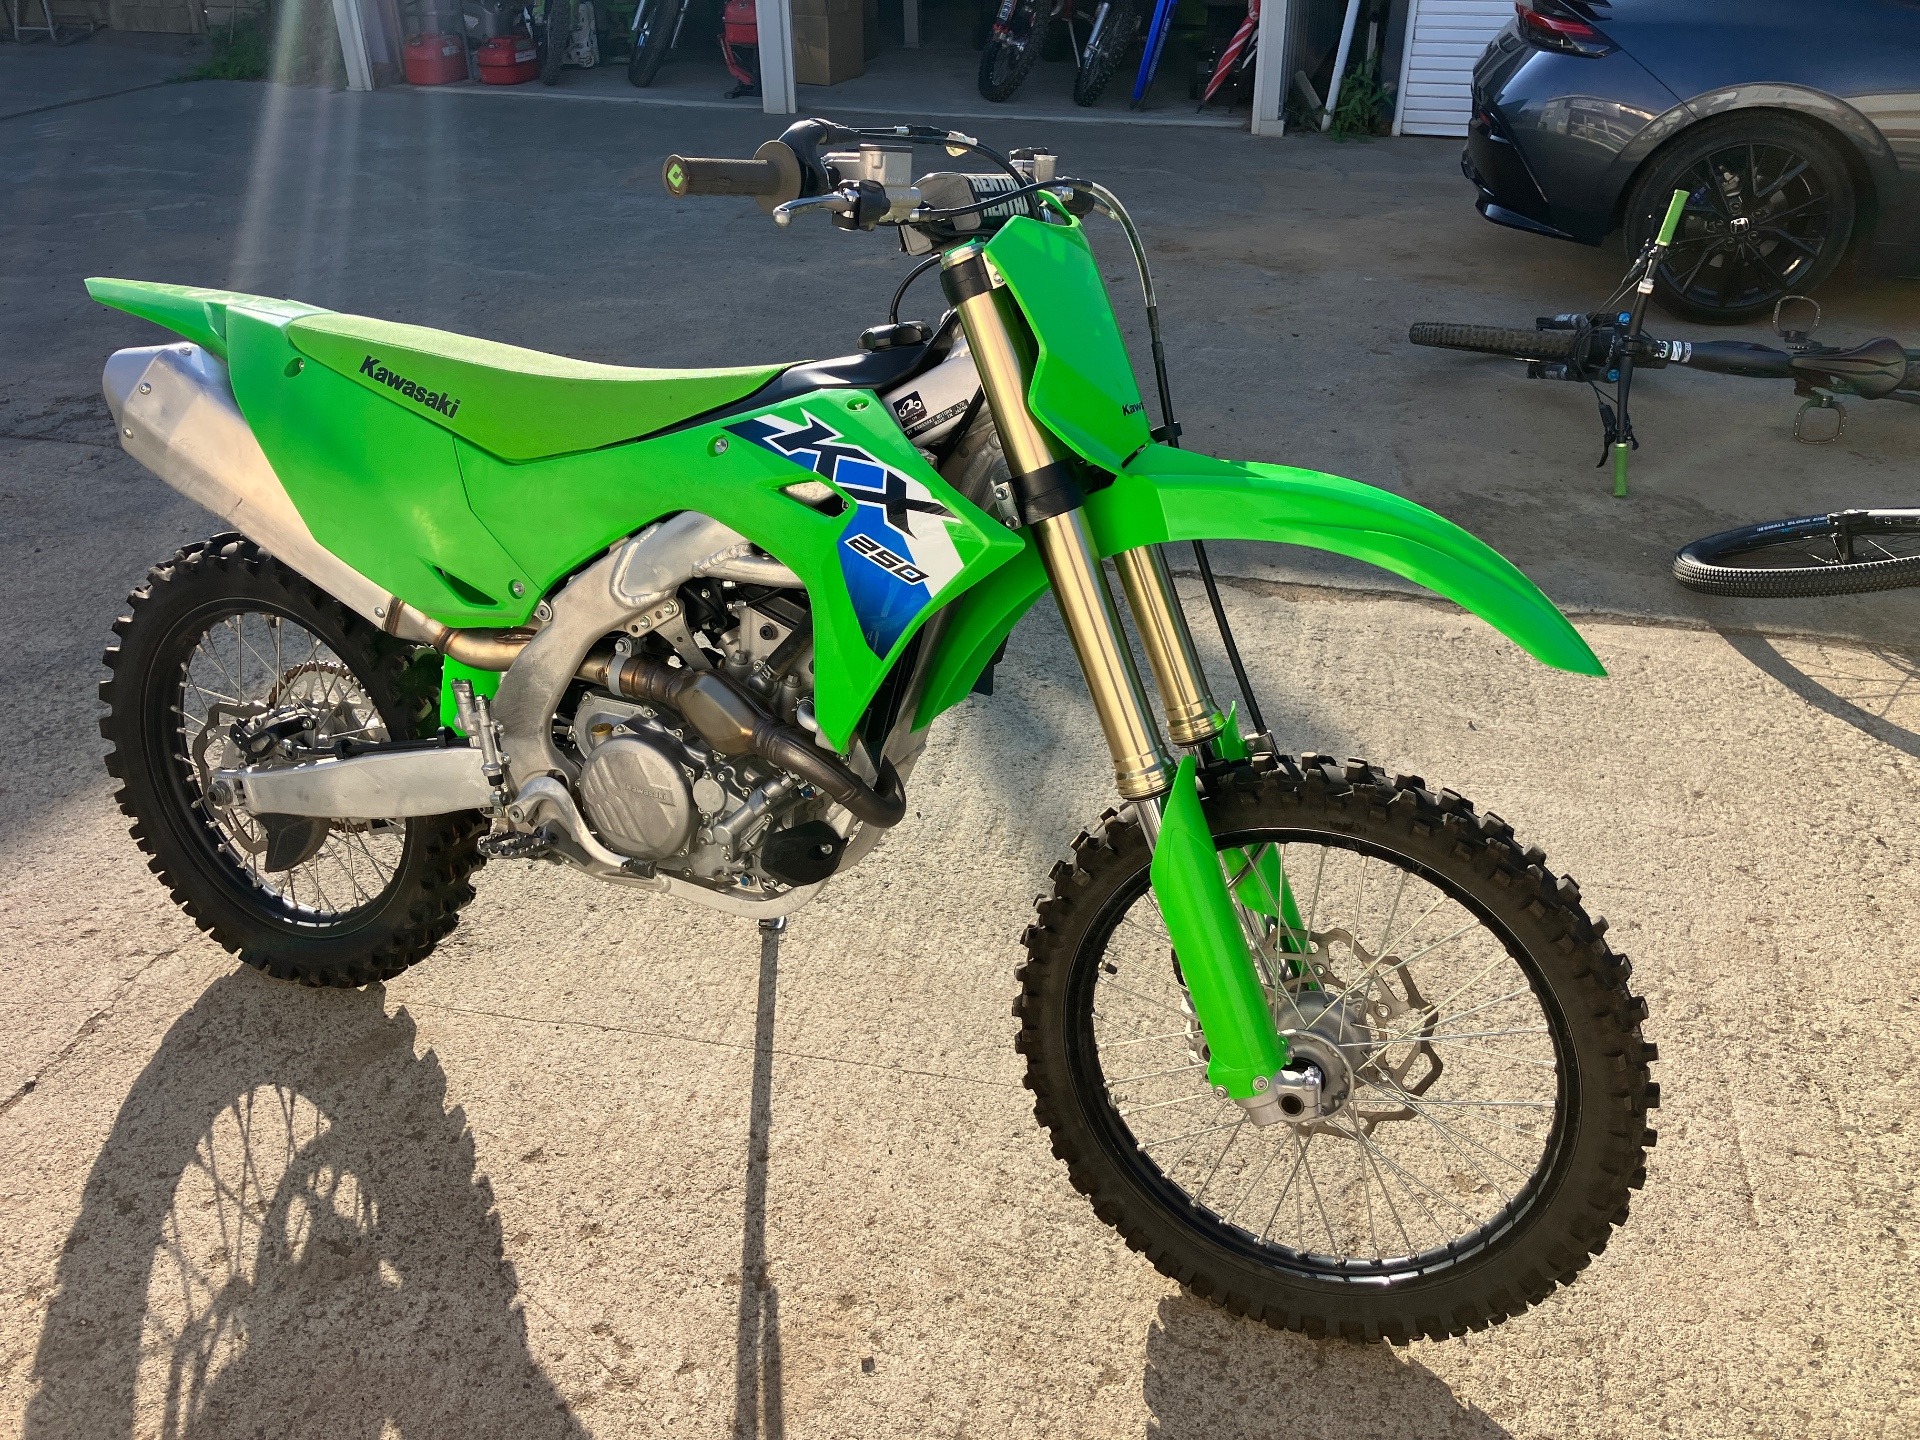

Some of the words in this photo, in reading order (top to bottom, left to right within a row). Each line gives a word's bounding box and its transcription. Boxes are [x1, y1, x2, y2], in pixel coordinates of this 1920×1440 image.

[359, 355, 461, 419] Kawasaki
[1122, 401, 1144, 417] Kaw
[767, 413, 961, 541] KX
[844, 533, 930, 585] 250
[625, 782, 667, 801] Kawasaki
